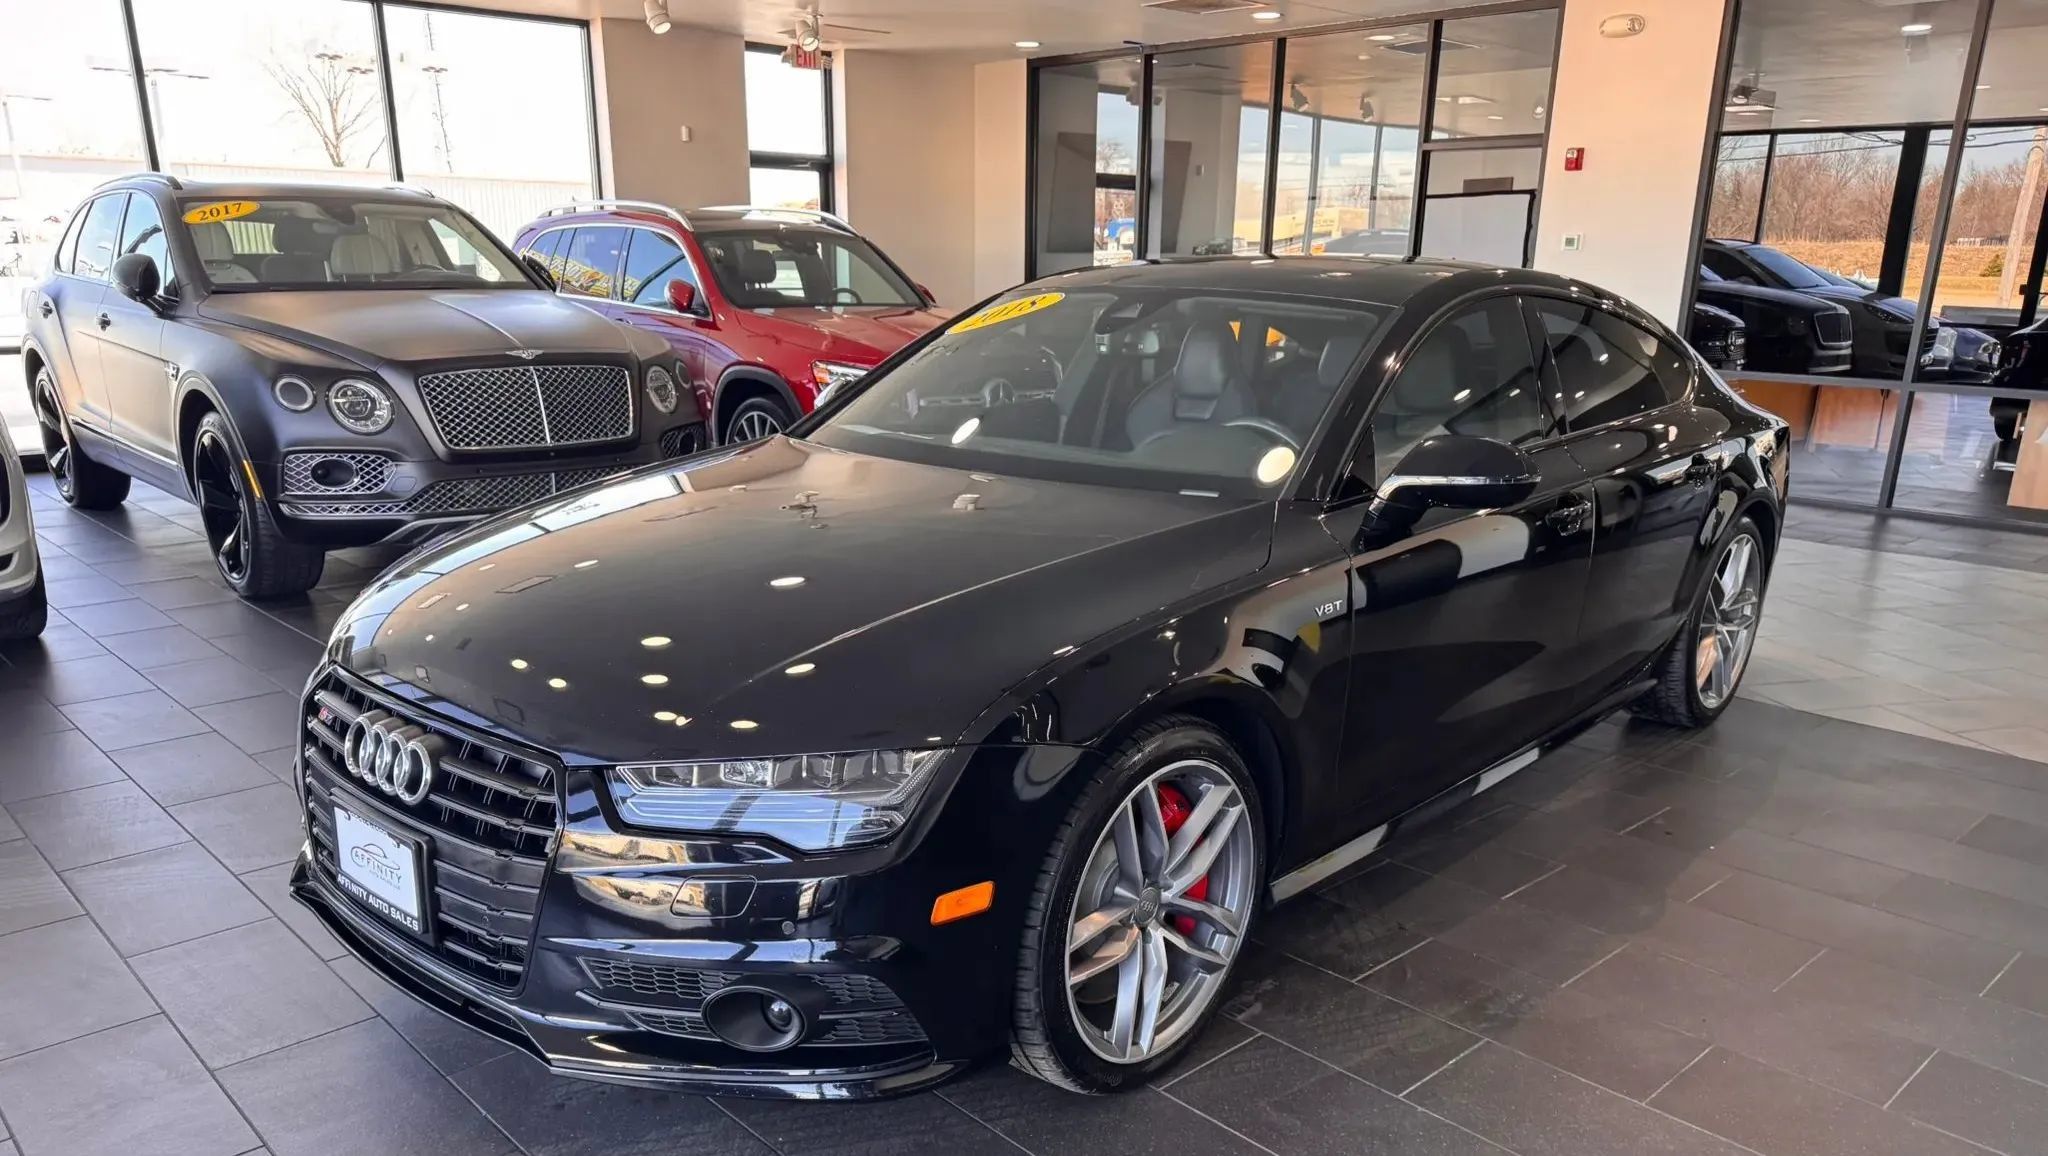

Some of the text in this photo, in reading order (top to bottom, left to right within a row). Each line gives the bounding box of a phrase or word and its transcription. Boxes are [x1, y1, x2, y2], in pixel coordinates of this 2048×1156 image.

[197, 202, 242, 221] 2017
[1314, 599, 1344, 617] V8T
[353, 849, 402, 884] AFFINITY
[337, 873, 368, 902] AFFINITY
[368, 893, 389, 915] AUTO
[390, 907, 419, 932] SALES
